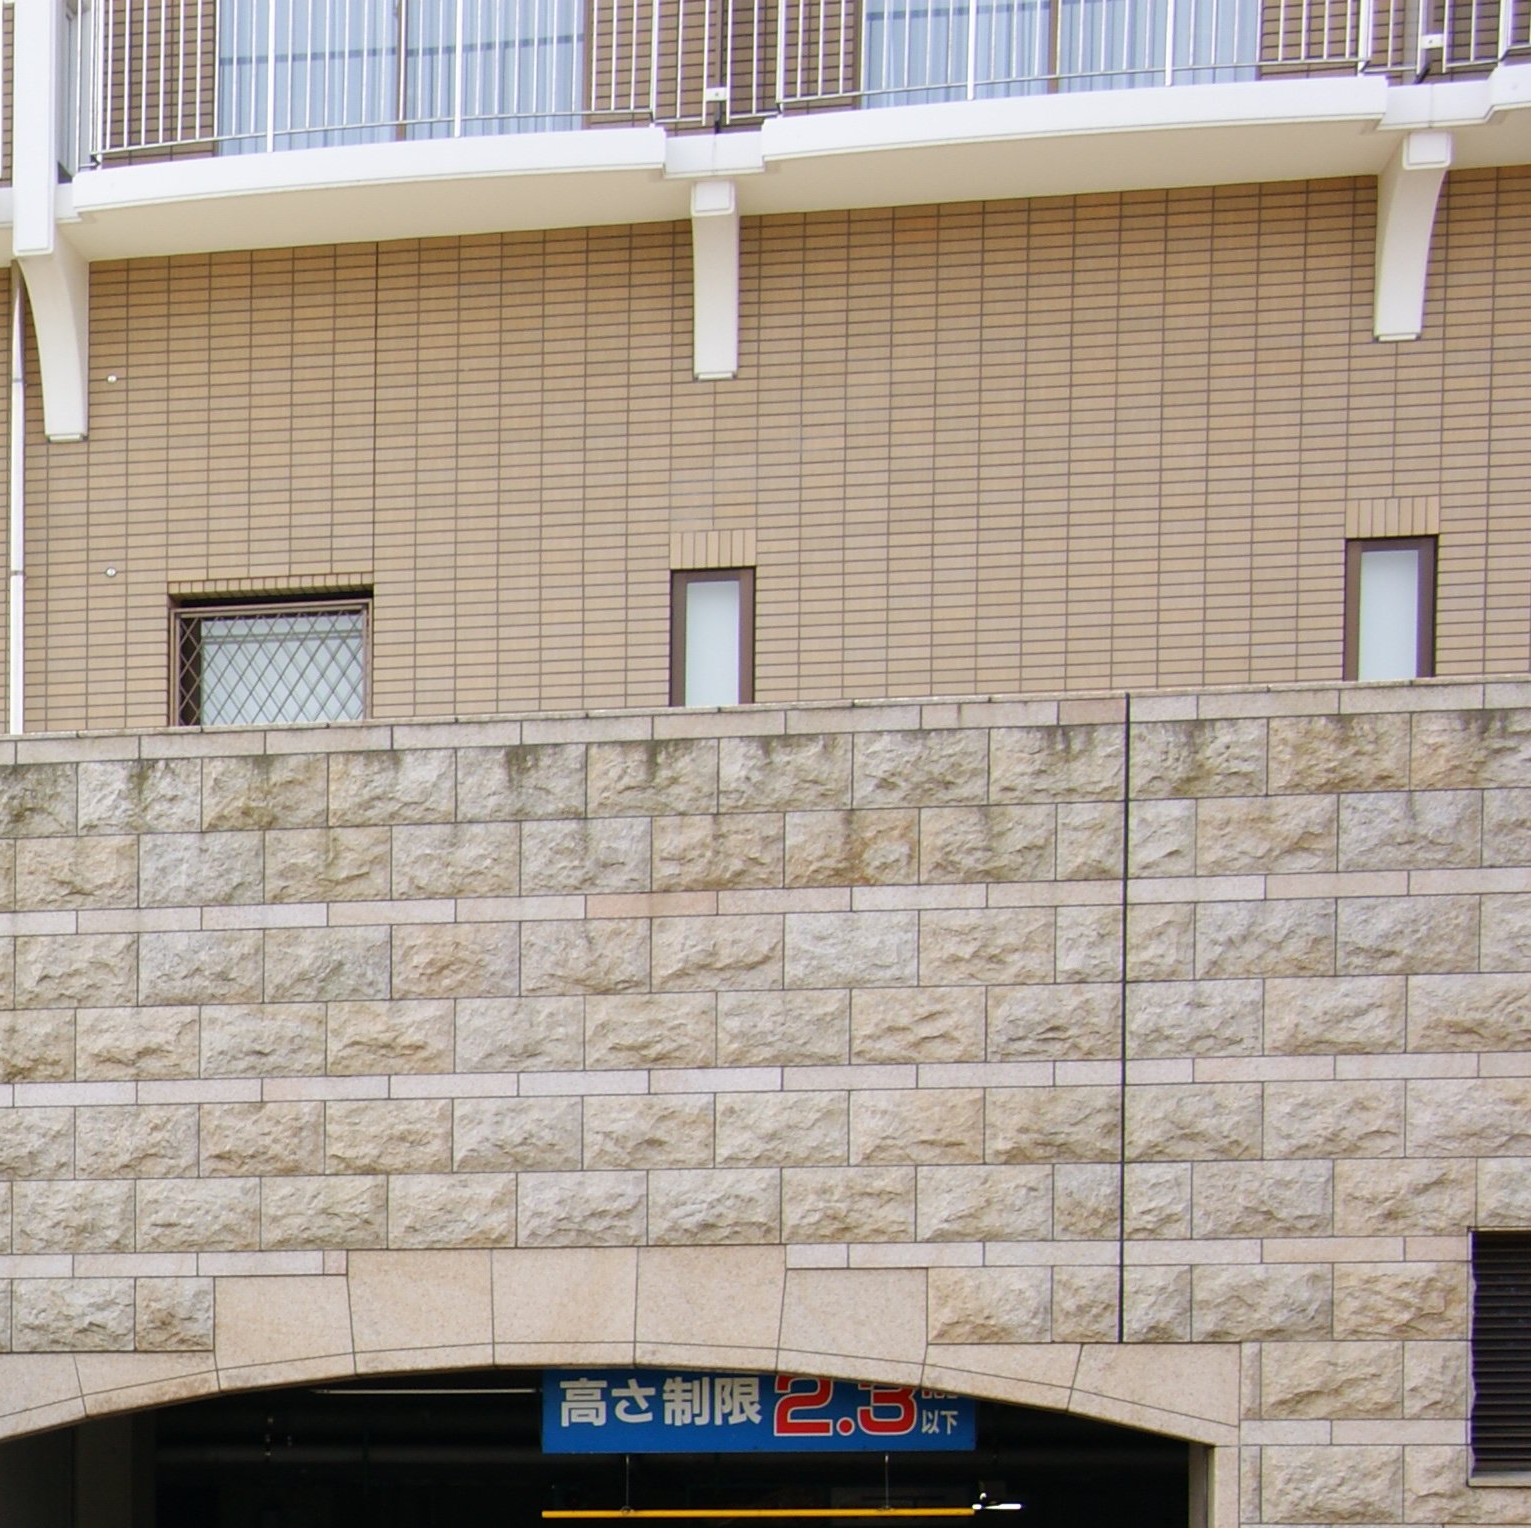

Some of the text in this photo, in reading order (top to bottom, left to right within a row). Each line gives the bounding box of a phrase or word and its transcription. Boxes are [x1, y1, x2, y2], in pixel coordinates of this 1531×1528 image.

[559, 1374, 959, 1437] 高さ制限 2.3 以下
